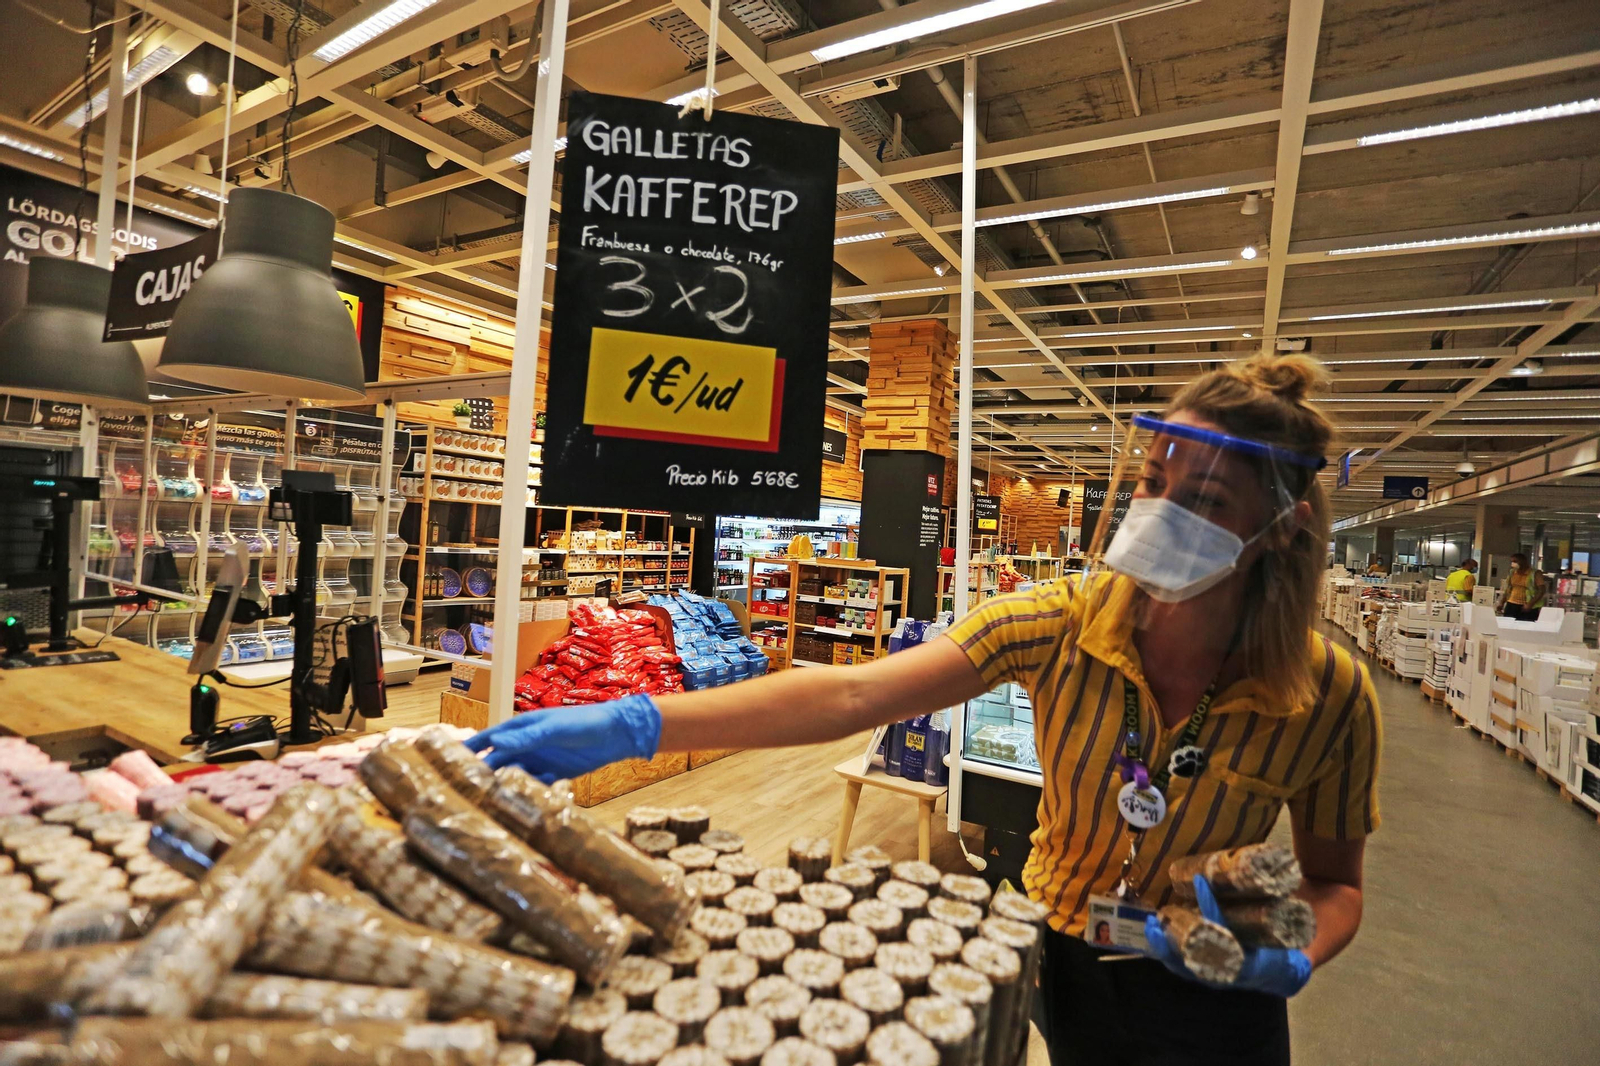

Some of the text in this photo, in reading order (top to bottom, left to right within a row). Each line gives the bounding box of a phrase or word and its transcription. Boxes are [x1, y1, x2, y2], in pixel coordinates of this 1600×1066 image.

[582, 120, 752, 168] GALLETAS
[583, 166, 799, 232] KAFFEREP
[8, 197, 157, 250] LÖRDAGSODIS
[581, 225, 650, 253] Frambuesa
[664, 245, 674, 254] o
[624, 354, 744, 413] 1€/ud
[50, 416, 146, 433] elige favoritas
[52, 405, 81, 416] Coge
[255, 438, 264, 446] te
[665, 464, 708, 486] Precio
